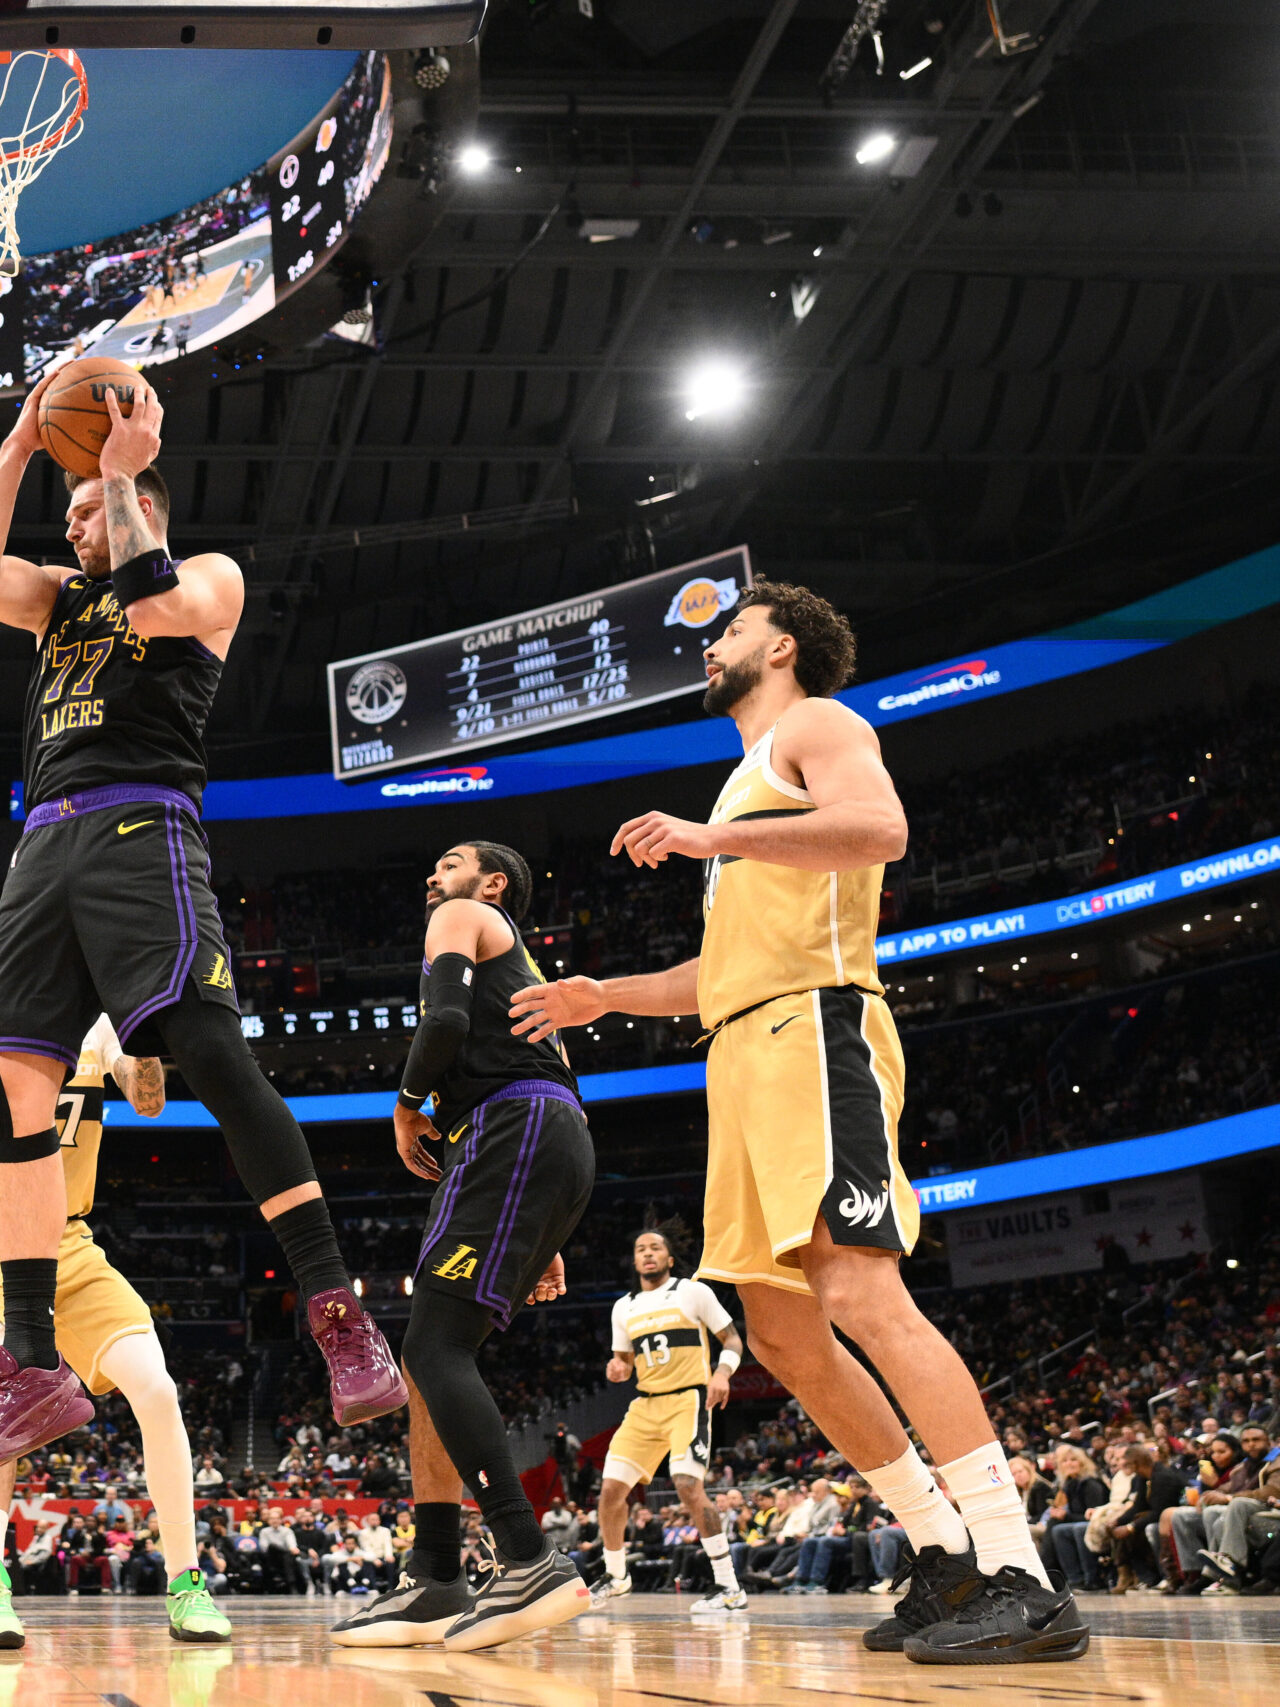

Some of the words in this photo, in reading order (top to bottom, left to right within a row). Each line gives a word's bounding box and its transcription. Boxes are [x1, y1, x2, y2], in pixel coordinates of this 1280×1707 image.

[460, 654, 480, 672] 22
[588, 618, 611, 635] 40
[461, 627, 514, 653] GAME
[516, 600, 605, 638] MATCHUP
[593, 635, 610, 653] 12
[43, 635, 115, 704] 77
[467, 688, 479, 702] 4
[594, 652, 612, 669] 12
[456, 701, 492, 723] 9/21
[583, 665, 628, 690] 17/25
[457, 717, 495, 739] 4/10
[587, 683, 626, 706] 5/10
[41, 699, 104, 740] LAKERS
[342, 745, 394, 770] WIZARDS
[1180, 844, 1280, 888] DOWNLOA
[899, 932, 937, 955] APP
[939, 926, 967, 946] TO
[970, 914, 1025, 941] PLAY!
[285, 1021, 296, 1034] 6
[350, 1018, 359, 1031] 3
[402, 1014, 417, 1027] 12
[986, 1207, 1070, 1240] VAULTS
[431, 1244, 478, 1280] LA
[640, 1333, 672, 1368] 13
